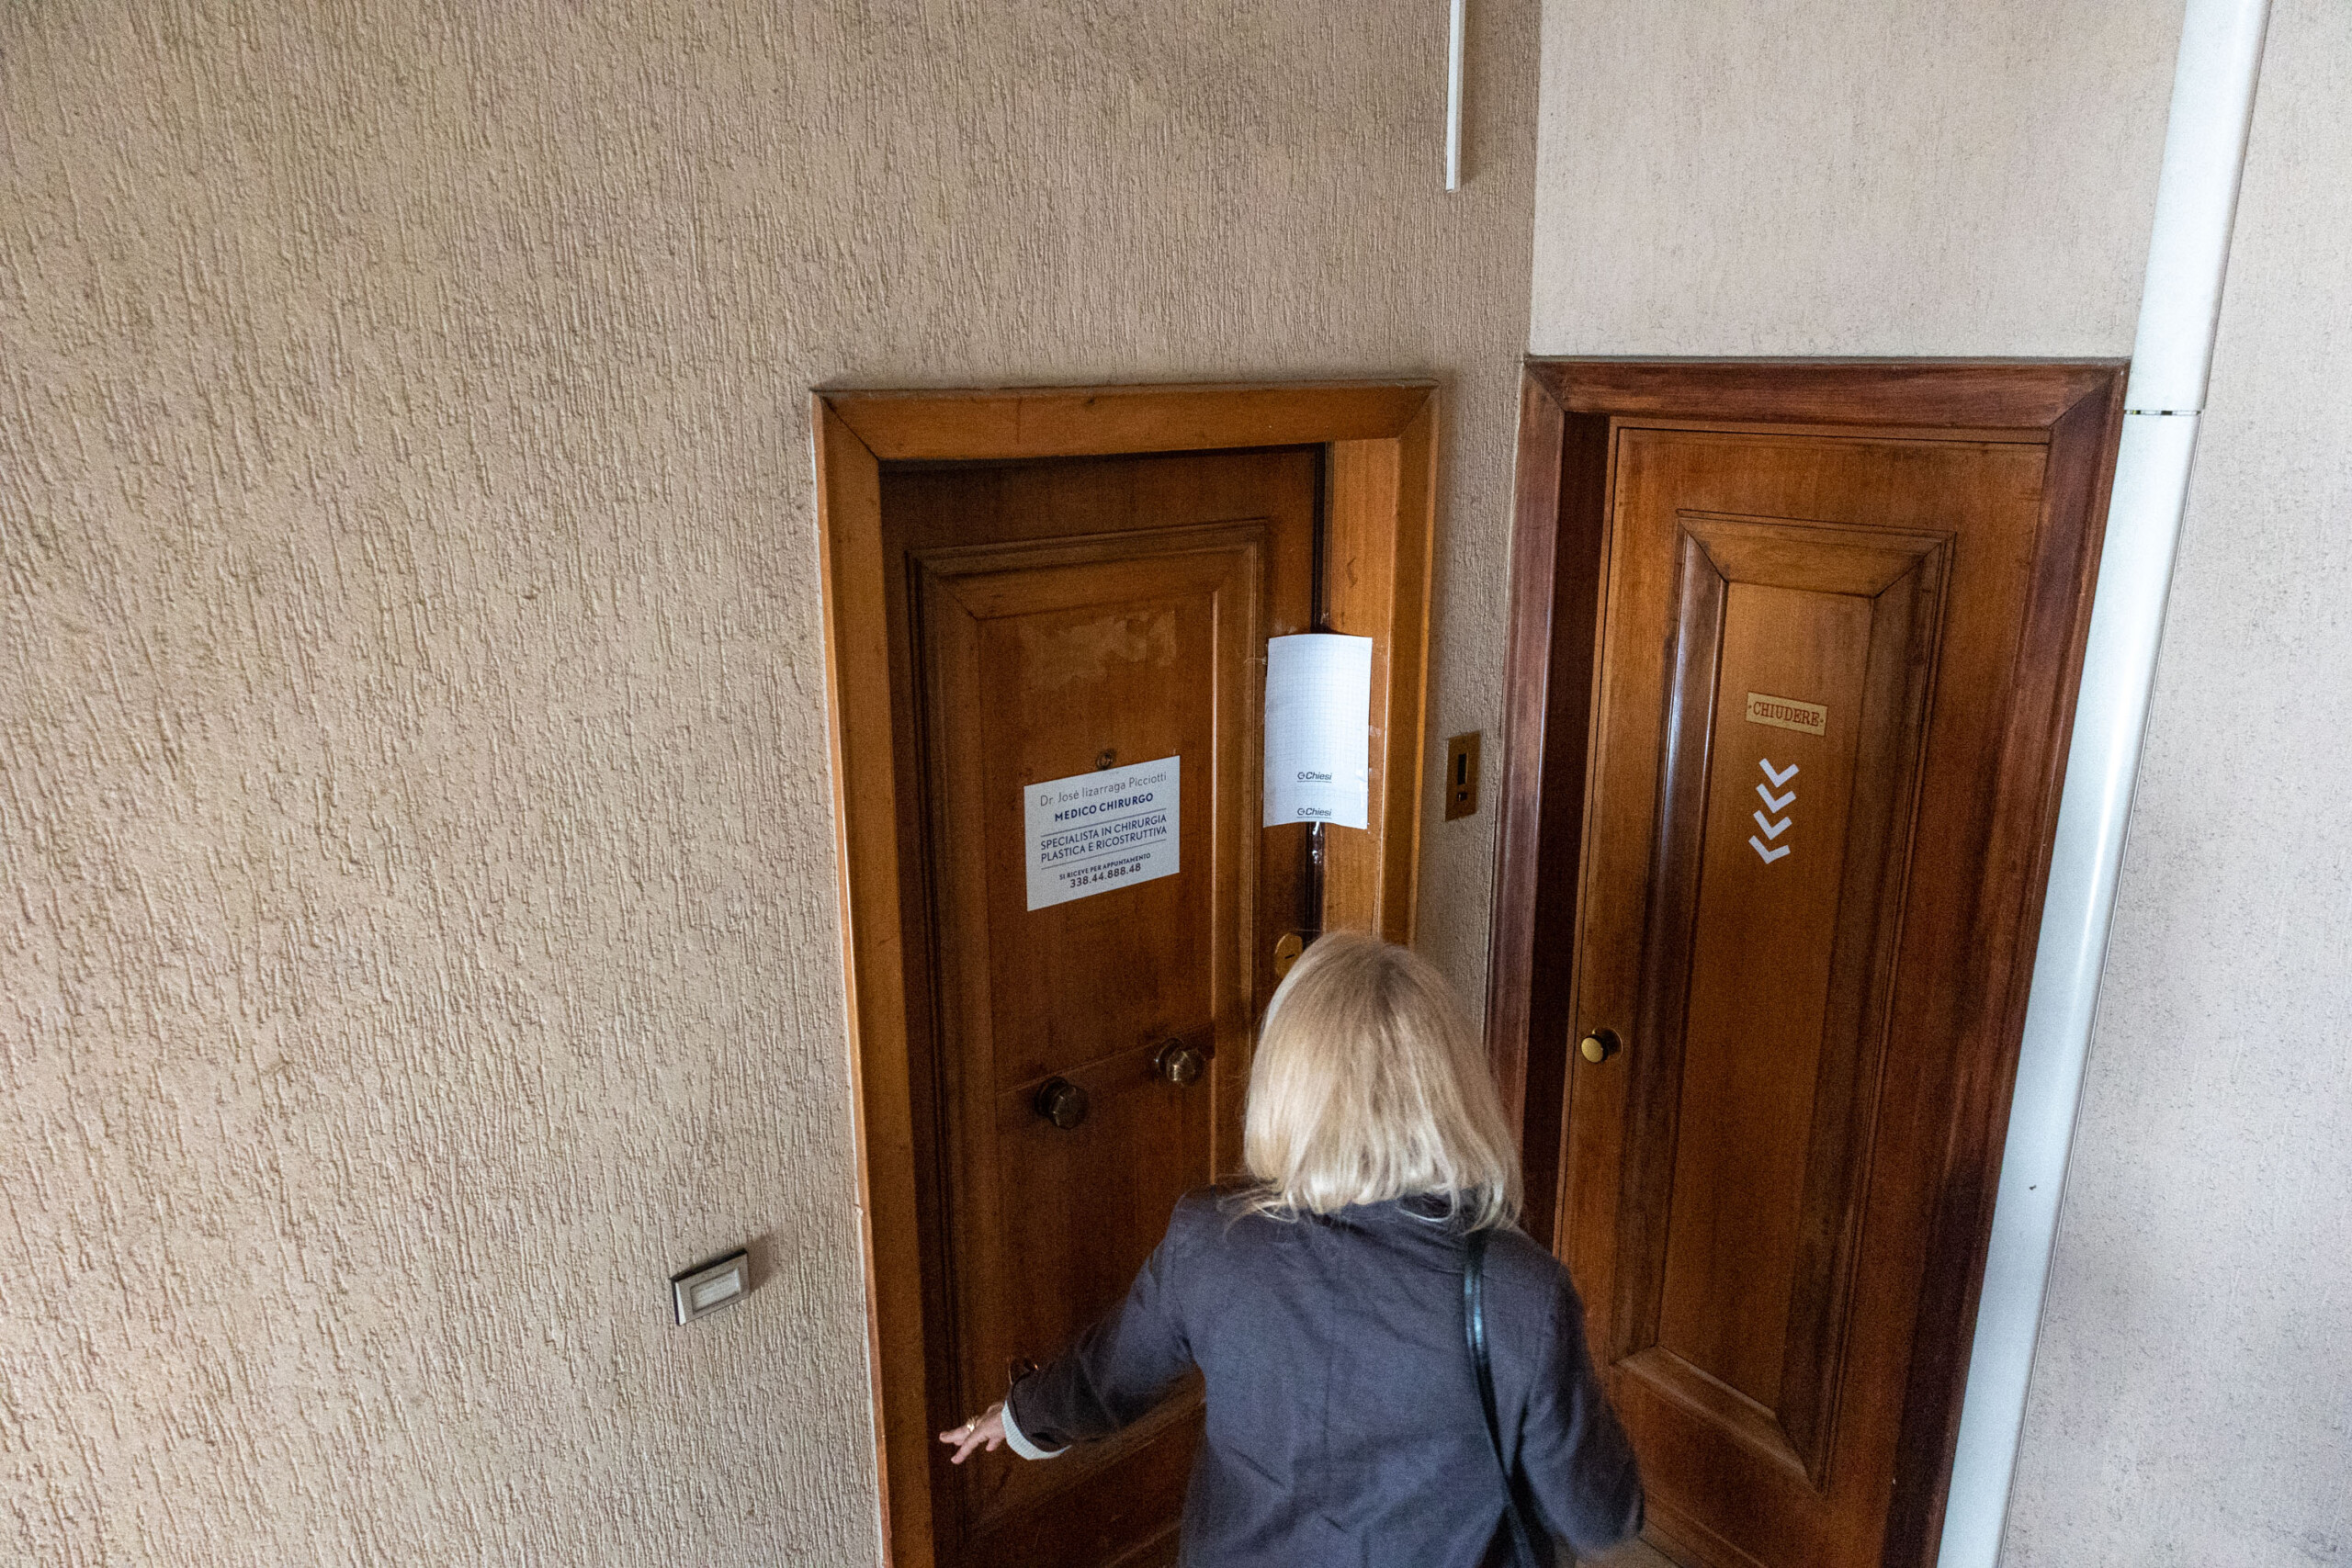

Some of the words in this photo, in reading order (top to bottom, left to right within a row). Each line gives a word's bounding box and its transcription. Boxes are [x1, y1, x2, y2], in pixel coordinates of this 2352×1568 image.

[1753, 701, 1820, 727] CHIUDERE
[1128, 772, 1167, 788] Picciotti
[1306, 772, 1332, 780] Chiesi
[1055, 805, 1097, 821] MEDICO
[1099, 793, 1154, 812] CHIRURGO
[1040, 829, 1100, 851] SPECIALISTA
[1102, 825, 1112, 837] IN
[1114, 814, 1167, 834] CHIRURGIA
[1041, 845, 1086, 863] PLASTICA
[1088, 841, 1094, 852] E
[1096, 826, 1167, 850] RICOSTRUTTIVA
[1067, 868, 1089, 879] RICEVE
[1102, 852, 1151, 870] APPUNTAMENTO
[1069, 863, 1141, 888] 338.44.888.48
